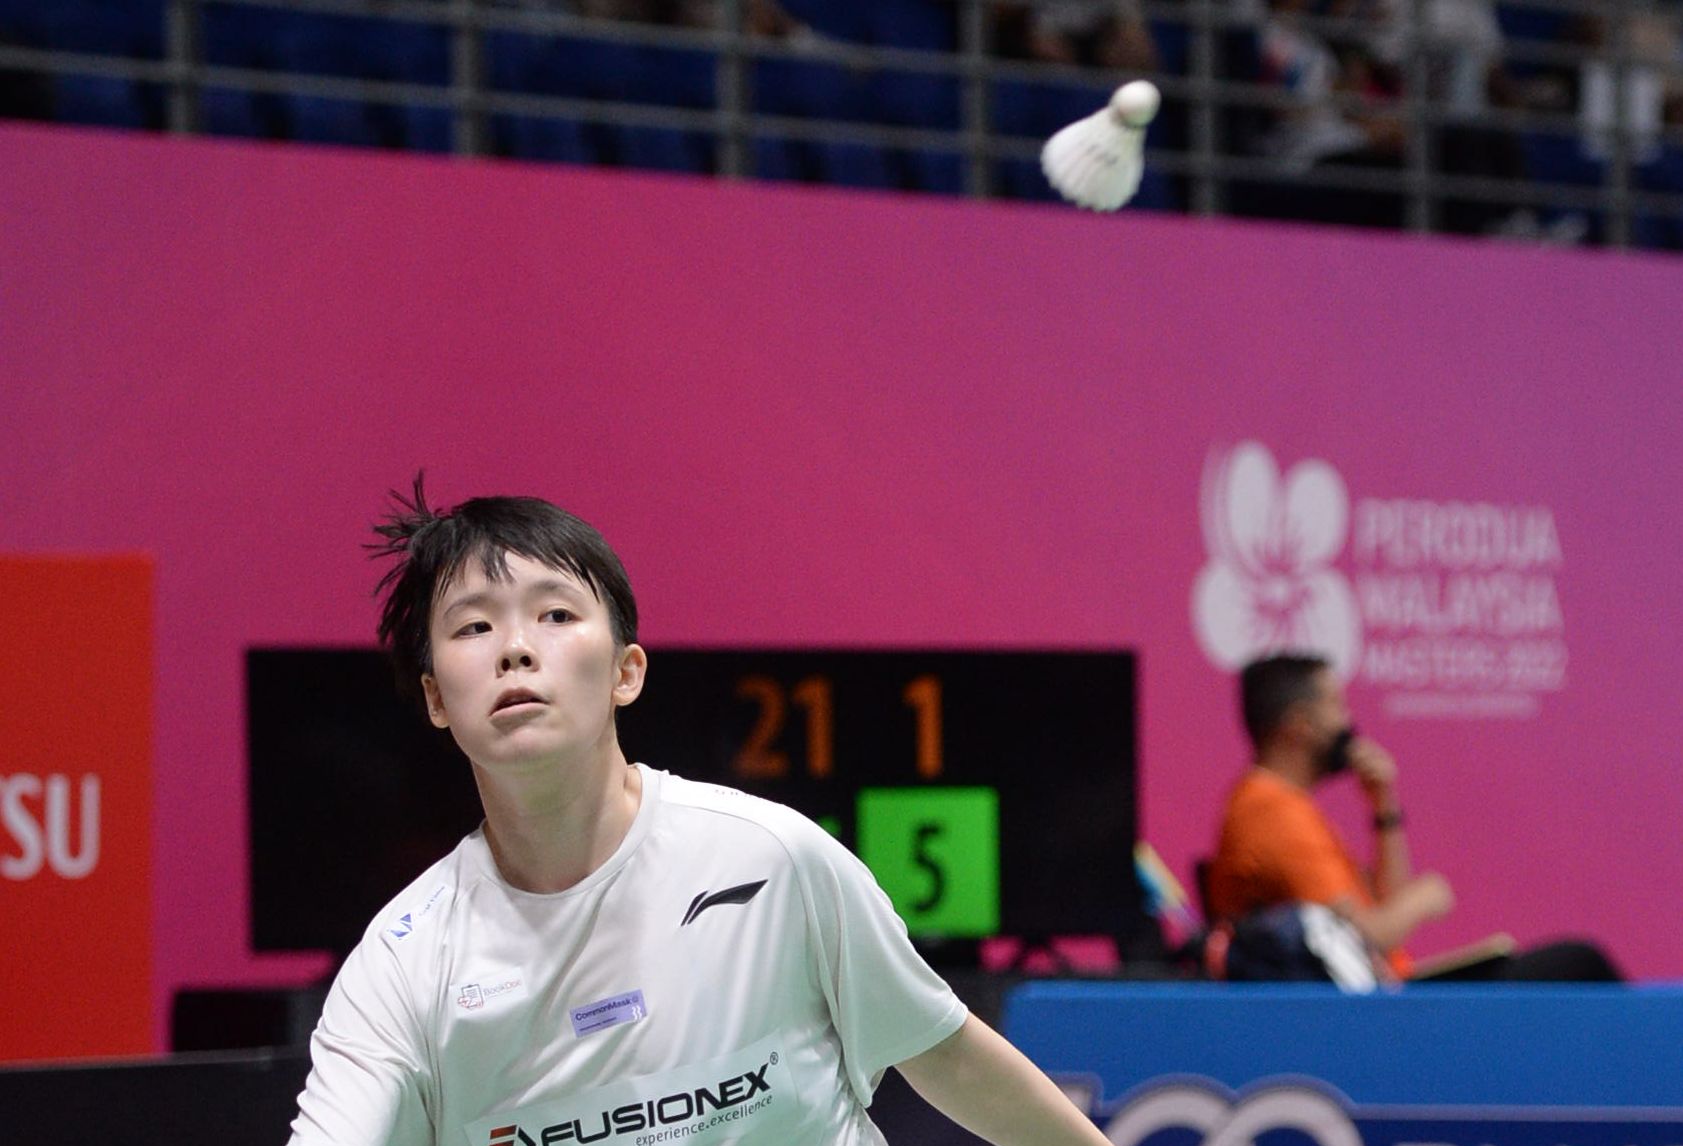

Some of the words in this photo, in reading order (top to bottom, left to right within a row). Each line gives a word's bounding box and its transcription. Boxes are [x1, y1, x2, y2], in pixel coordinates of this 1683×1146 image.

[1354, 497, 1562, 567] PERODUA
[1356, 572, 1564, 635] MALAYSIA
[732, 673, 834, 780] 21
[903, 673, 944, 780] 1
[0, 772, 101, 881] SU
[911, 822, 946, 915] 5
[575, 998, 632, 1021] CommonMask
[635, 1094, 773, 1146] experience.excellence
